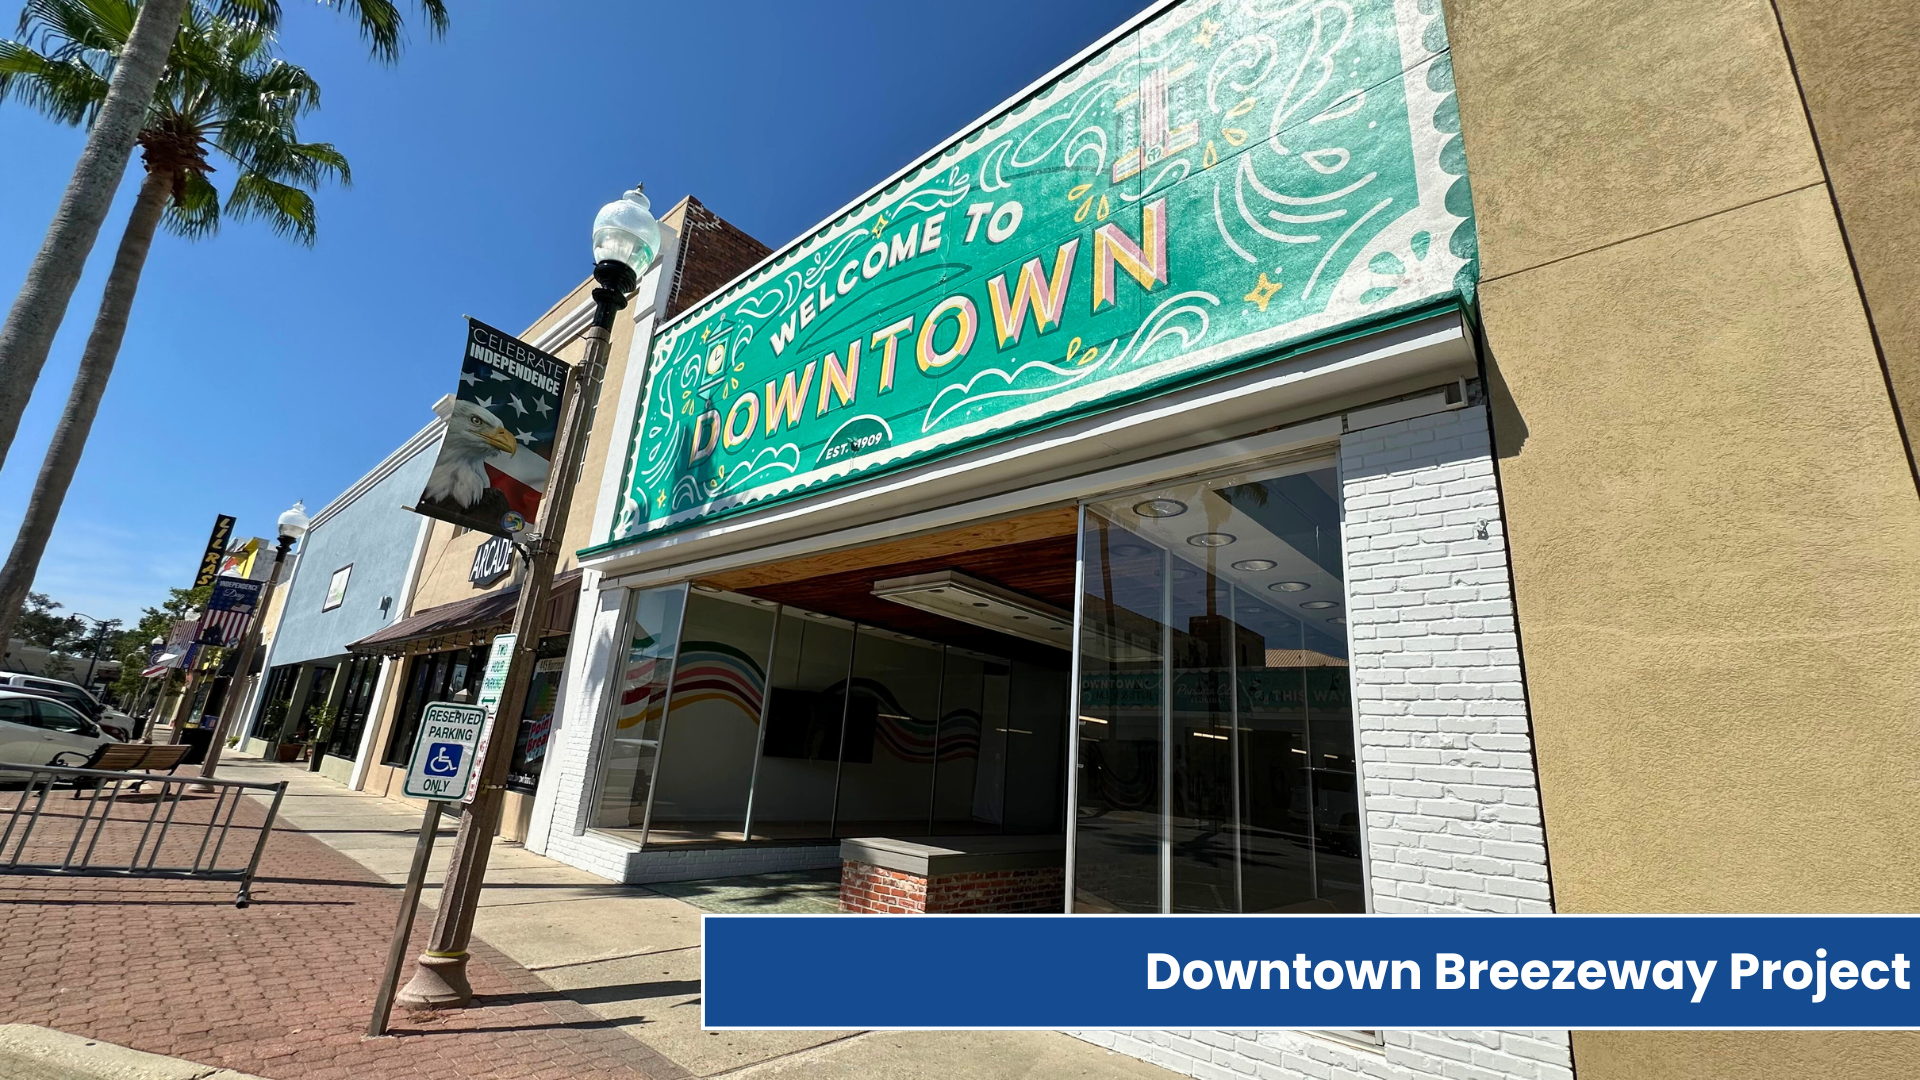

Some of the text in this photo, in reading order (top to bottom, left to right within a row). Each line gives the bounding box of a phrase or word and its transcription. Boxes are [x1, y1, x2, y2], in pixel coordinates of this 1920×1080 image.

[769, 200, 1023, 357] WELCOME TO
[688, 198, 1169, 468] DOWNTOWN
[473, 327, 563, 381] CELEBRATE
[470, 341, 560, 397] INDEPENDENCE
[825, 432, 883, 461] EST. 1909
[212, 517, 231, 550] LIL
[469, 538, 514, 581] ARCADE
[220, 580, 260, 592] INDEPENDENCE
[223, 588, 245, 600] Day
[1082, 679, 1143, 689] OWNTOWN
[1272, 690, 1304, 701] THIS
[1313, 690, 1347, 702] WAY
[428, 709, 482, 726] RESERVED
[428, 726, 473, 741] PARKING
[526, 733, 549, 754] Brea
[423, 778, 450, 793] ONLY
